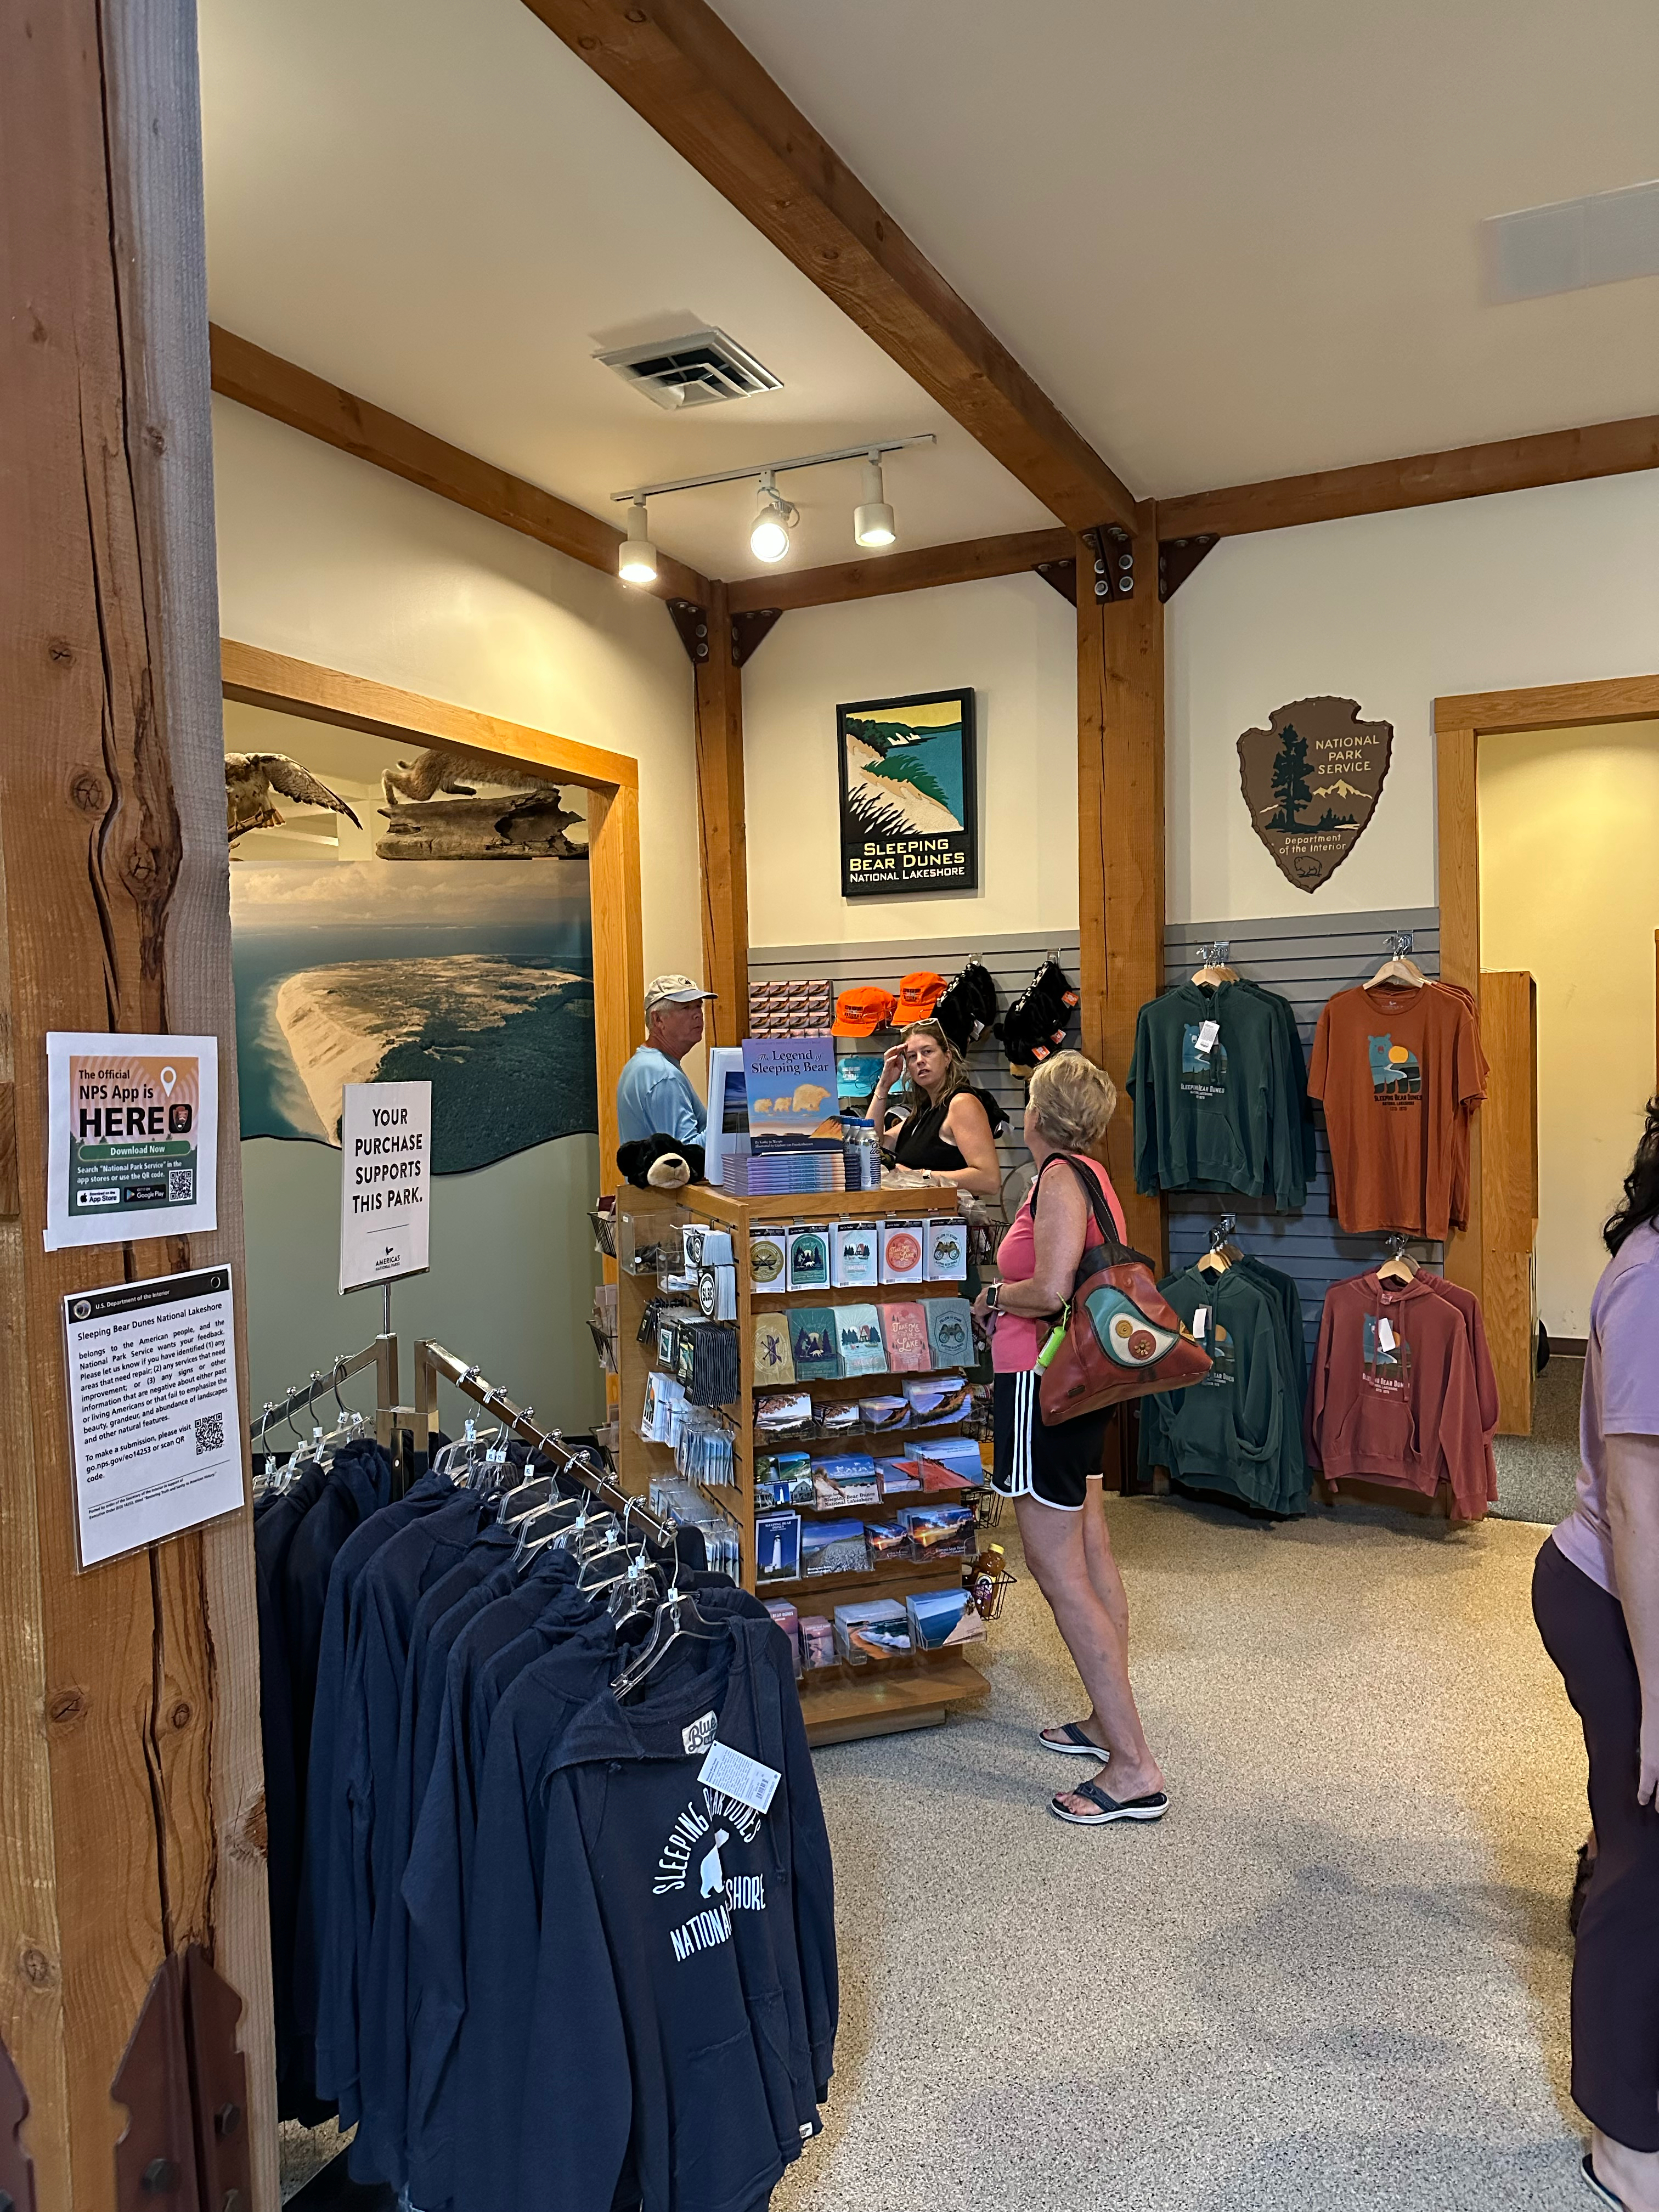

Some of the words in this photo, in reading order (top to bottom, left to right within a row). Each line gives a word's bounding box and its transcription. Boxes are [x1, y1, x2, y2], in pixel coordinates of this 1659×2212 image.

[1316, 735, 1380, 750] NATIONAL
[1329, 749, 1362, 761] PARK
[1318, 761, 1372, 775] SERVICE
[864, 839, 949, 856] SLEEPING
[1279, 846, 1289, 855] of
[1291, 844, 1306, 853] the
[1310, 842, 1346, 852] Interior
[1285, 834, 1341, 845] Department
[850, 857, 895, 871] BEAR
[903, 851, 964, 868] DUNES
[850, 872, 899, 883] NATIONAL
[902, 866, 965, 879] LAKESHORE
[772, 1049, 812, 1063] Legend
[814, 1053, 822, 1062] of
[79, 1069, 95, 1079] The
[98, 1069, 129, 1079] Official
[751, 1063, 801, 1076] Sleeping
[803, 1062, 829, 1071] Bear
[80, 1085, 108, 1099] NPS
[112, 1085, 139, 1103] App
[143, 1084, 154, 1098] is
[80, 1107, 164, 1137] HERE
[372, 1108, 408, 1127] YOUR
[110, 1145, 148, 1156] Download
[149, 1145, 165, 1153] Now
[355, 1133, 422, 1157] PURCHASE
[356, 1160, 421, 1185] SUPPORTS
[352, 1193, 382, 1214] THIS
[387, 1187, 422, 1208] PARK.
[106, 1297, 136, 1307] Department
[78, 1328, 111, 1341] Sleeping
[113, 1324, 130, 1333] Bear
[132, 1318, 155, 1328] Dunes
[156, 1310, 187, 1323] National
[188, 1303, 222, 1316] Lakeshore
[79, 1348, 105, 1359] belongs
[139, 1334, 168, 1345] American
[173, 1327, 195, 1338] people,
[199, 1322, 211, 1330] and
[80, 1357, 108, 1370] National
[112, 1353, 127, 1362] Park
[131, 1347, 154, 1358] Service
[157, 1341, 176, 1351] wants
[180, 1337, 194, 1347] your
[198, 1329, 225, 1341] feedback.
[80, 1370, 101, 1381] Please
[122, 1361, 140, 1370] know
[148, 1356, 160, 1365] you
[161, 1352, 176, 1361] have
[177, 1343, 205, 1356] identified
[81, 1382, 99, 1391] areas
[100, 1378, 114, 1386] that
[115, 1372, 131, 1383] need
[154, 1364, 162, 1373] (2)
[175, 1356, 198, 1367] services
[199, 1352, 211, 1361] that
[212, 1347, 225, 1357] need
[82, 1385, 127, 1402] improvement;
[147, 1376, 155, 1385] (3)
[178, 1367, 193, 1376] signs
[211, 1358, 227, 1367] other
[82, 1397, 121, 1413] information
[123, 1393, 137, 1401] that
[150, 1382, 176, 1394] negative
[177, 1376, 195, 1386] about
[196, 1372, 213, 1381] either
[215, 1368, 227, 1377] past
[83, 1422, 108, 1434] beauty,
[110, 1413, 140, 1428] grandeur,
[142, 1407, 154, 1417] and
[155, 1400, 188, 1413] abundance
[197, 1387, 228, 1401] landscapes
[91, 1411, 110, 1421] living
[111, 1401, 145, 1415] Americans
[154, 1394, 167, 1403] that
[168, 1391, 178, 1399] fail
[187, 1381, 217, 1394] emphasize
[84, 1434, 97, 1444] and
[99, 1430, 117, 1440] other
[118, 1421, 141, 1435] natural
[143, 1415, 170, 1427] features.
[95, 1449, 113, 1459] make
[120, 1435, 157, 1452] submission,
[158, 1429, 178, 1441] please
[178, 1424, 191, 1433] visit
[86, 1446, 151, 1474] go.nps.gov/eo14253
[161, 1440, 174, 1449] scan
[176, 1436, 185, 1444] QR
[87, 1472, 105, 1483] code.
[688, 1717, 718, 1752] Blue
[652, 1801, 709, 1894] SLEEPING
